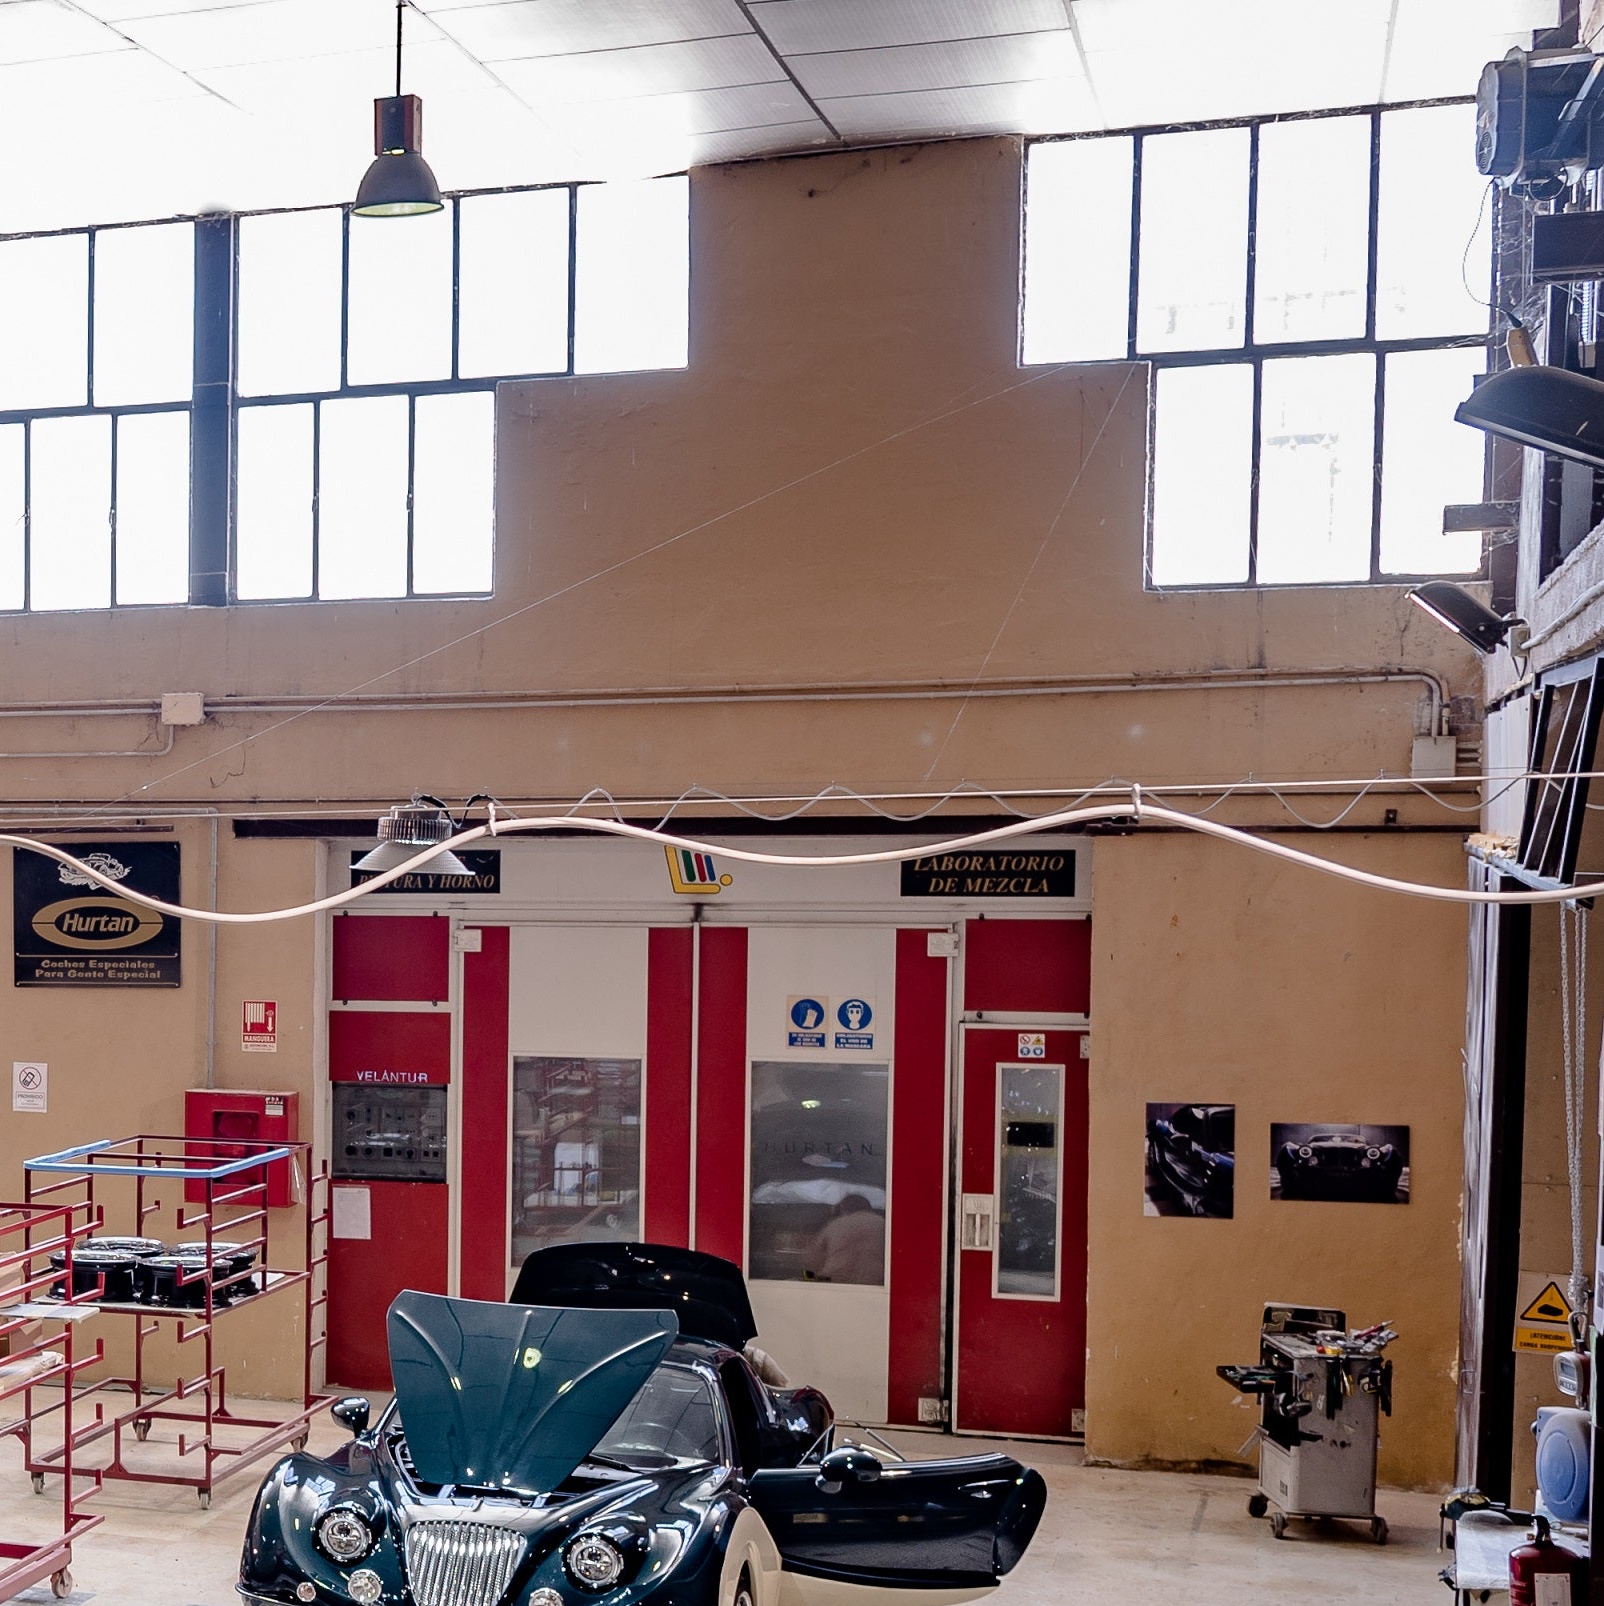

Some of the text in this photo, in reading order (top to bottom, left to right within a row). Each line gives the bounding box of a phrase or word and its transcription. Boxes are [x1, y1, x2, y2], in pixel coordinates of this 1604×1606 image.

[914, 855, 1064, 871] LABORATORIO
[359, 875, 495, 889] PURA Y HORNO
[929, 878, 1049, 893] DE MEZCLA
[62, 913, 134, 932] Hurtan
[41, 959, 155, 970] Coches Especiales
[35, 969, 161, 980] Para Gente Especial
